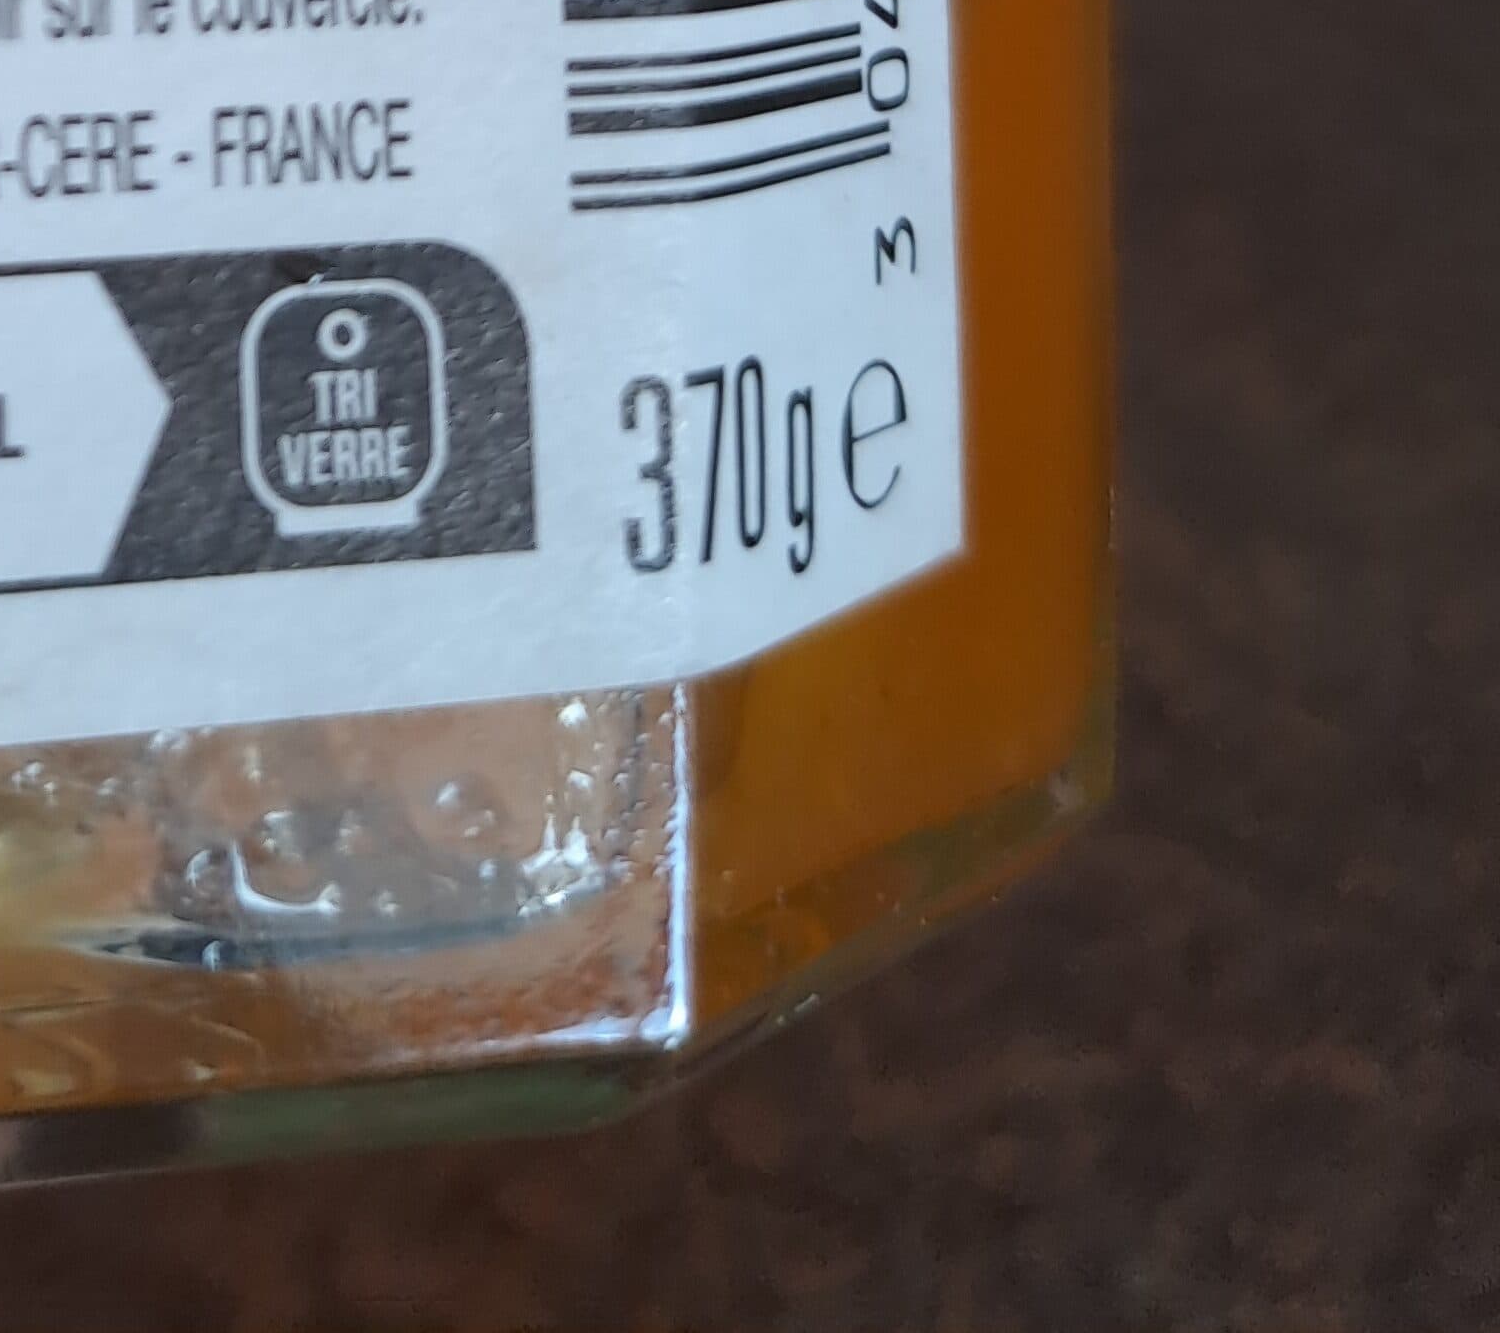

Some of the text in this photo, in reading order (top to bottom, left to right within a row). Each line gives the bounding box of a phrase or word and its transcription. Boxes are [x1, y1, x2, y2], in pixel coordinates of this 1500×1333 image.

[211, 98, 413, 188] FRANCE
[309, 367, 377, 429] TRI
[277, 423, 412, 488] VERRE
[620, 355, 816, 574] 370g
